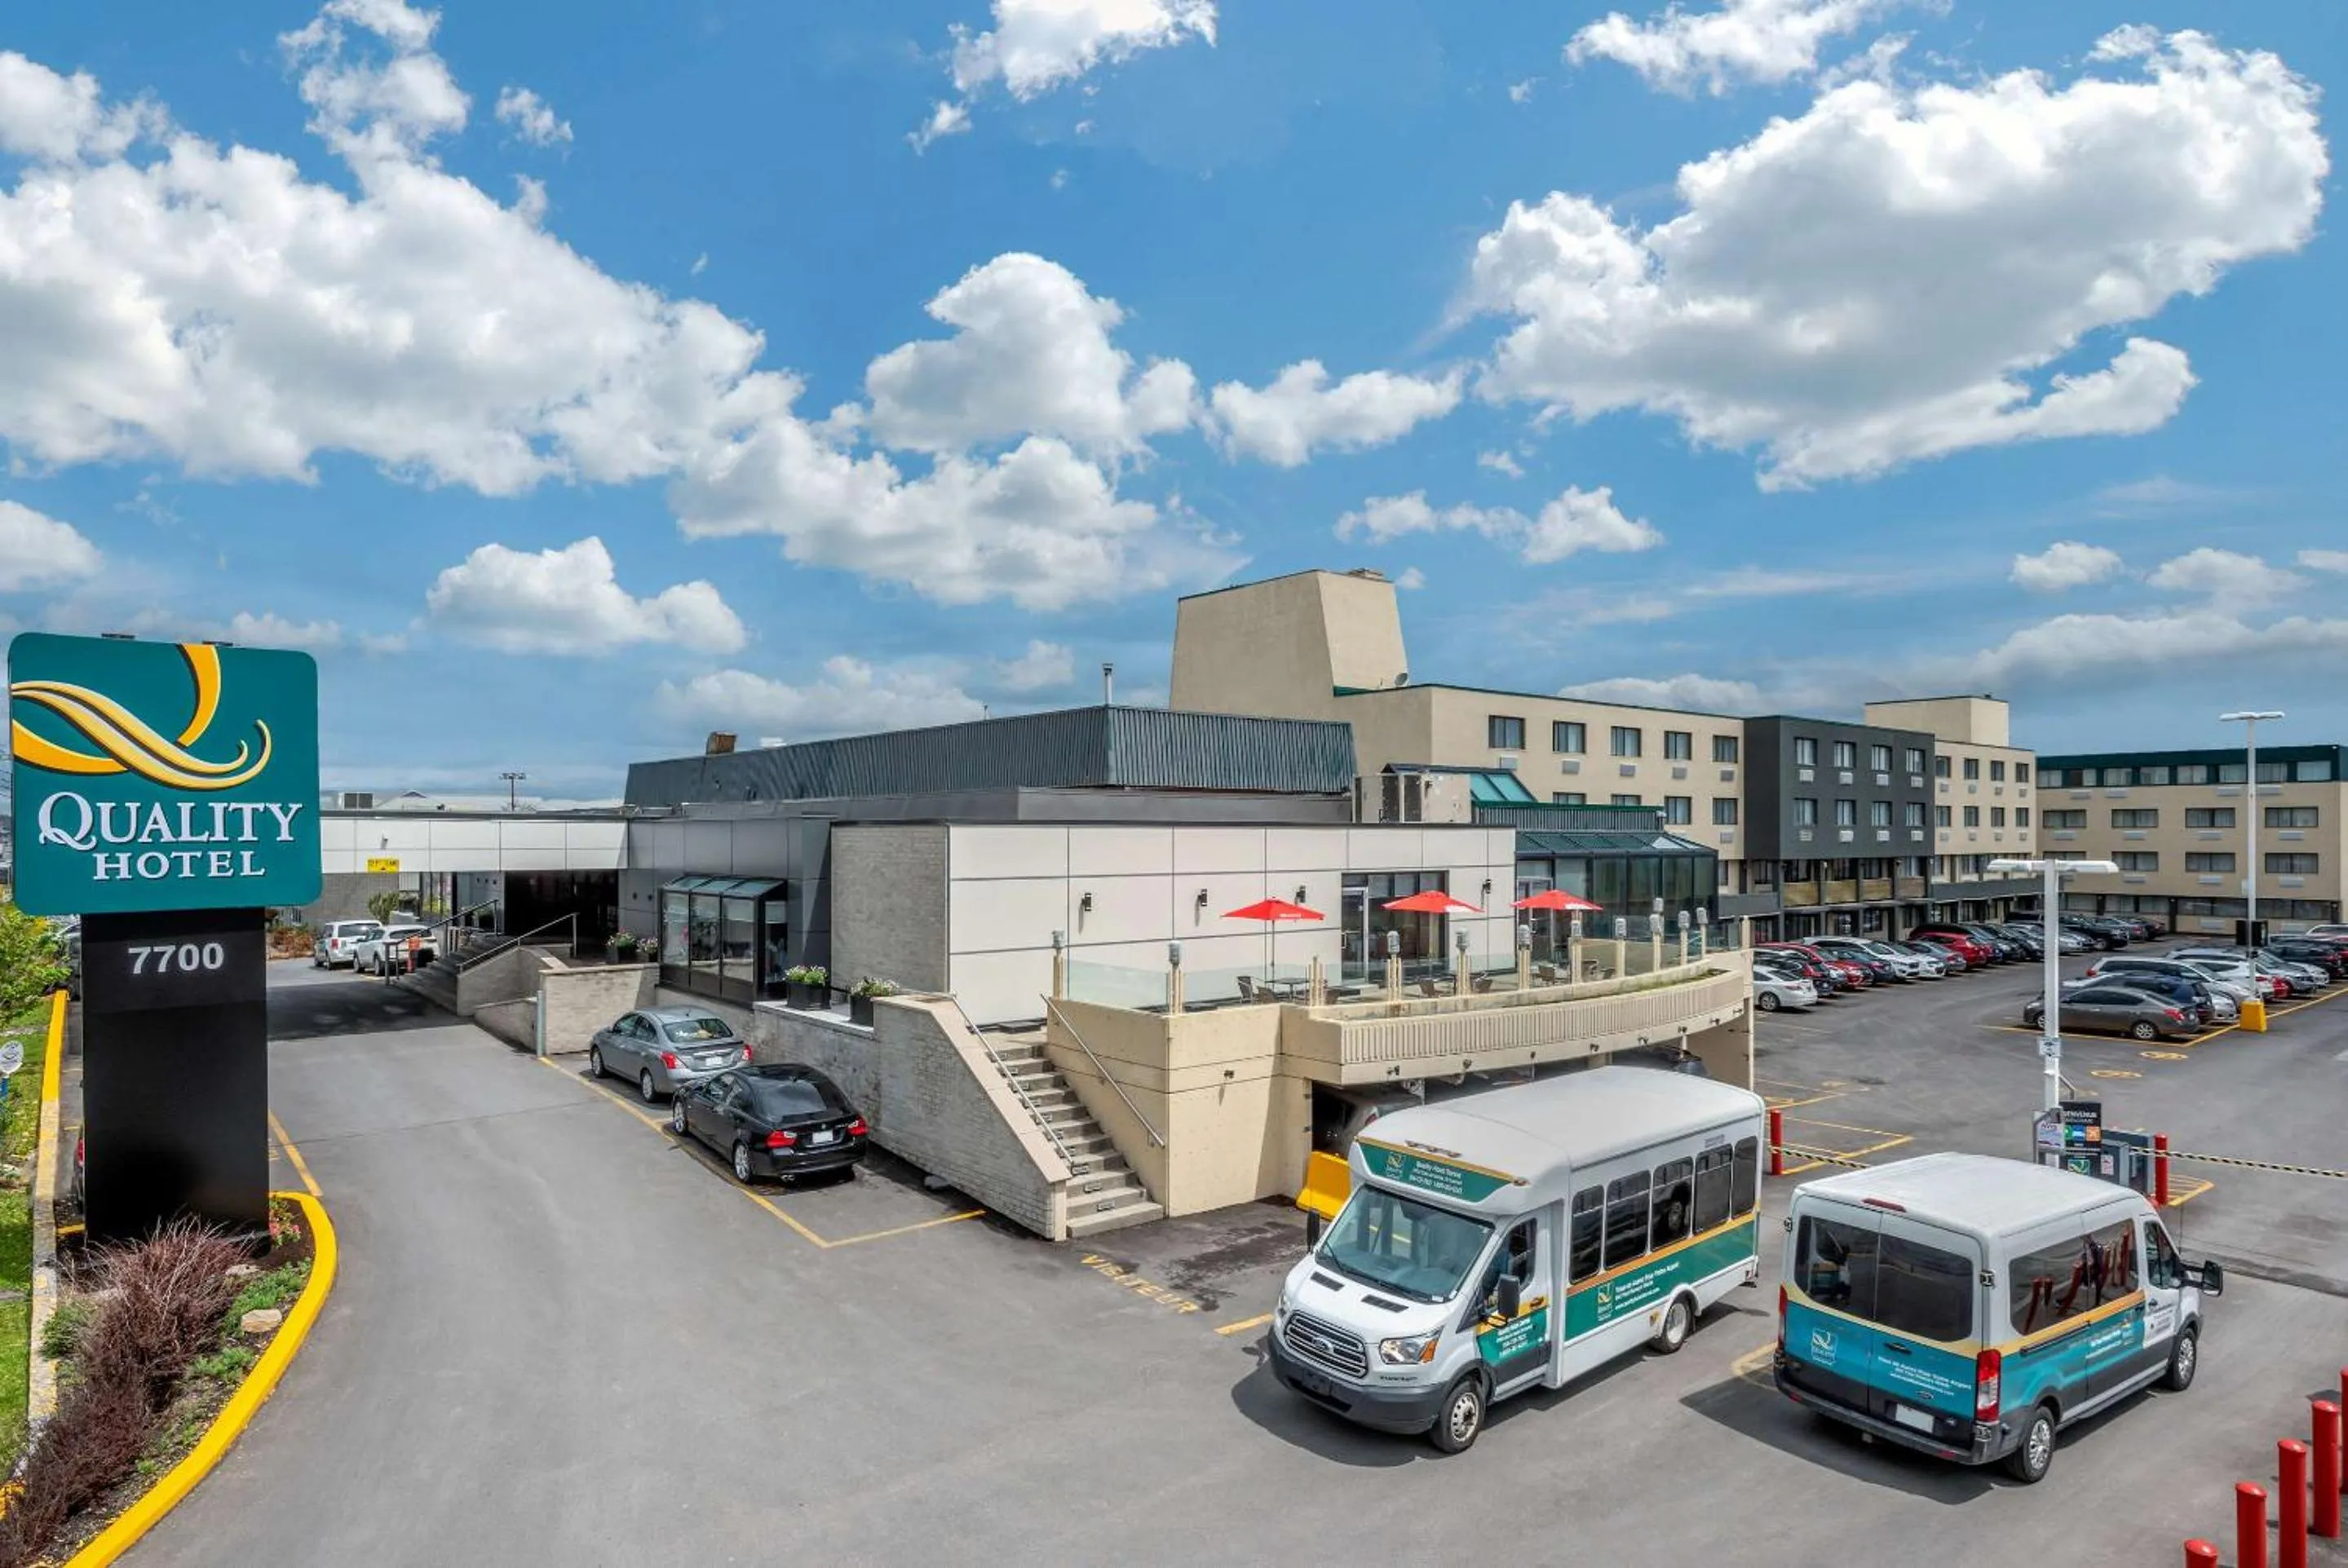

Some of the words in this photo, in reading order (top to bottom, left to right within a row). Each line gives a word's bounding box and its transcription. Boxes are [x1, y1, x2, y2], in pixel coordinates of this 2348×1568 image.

[38, 791, 303, 851] QUALITY
[92, 850, 266, 881] HOTEL
[128, 943, 225, 975] 7700
